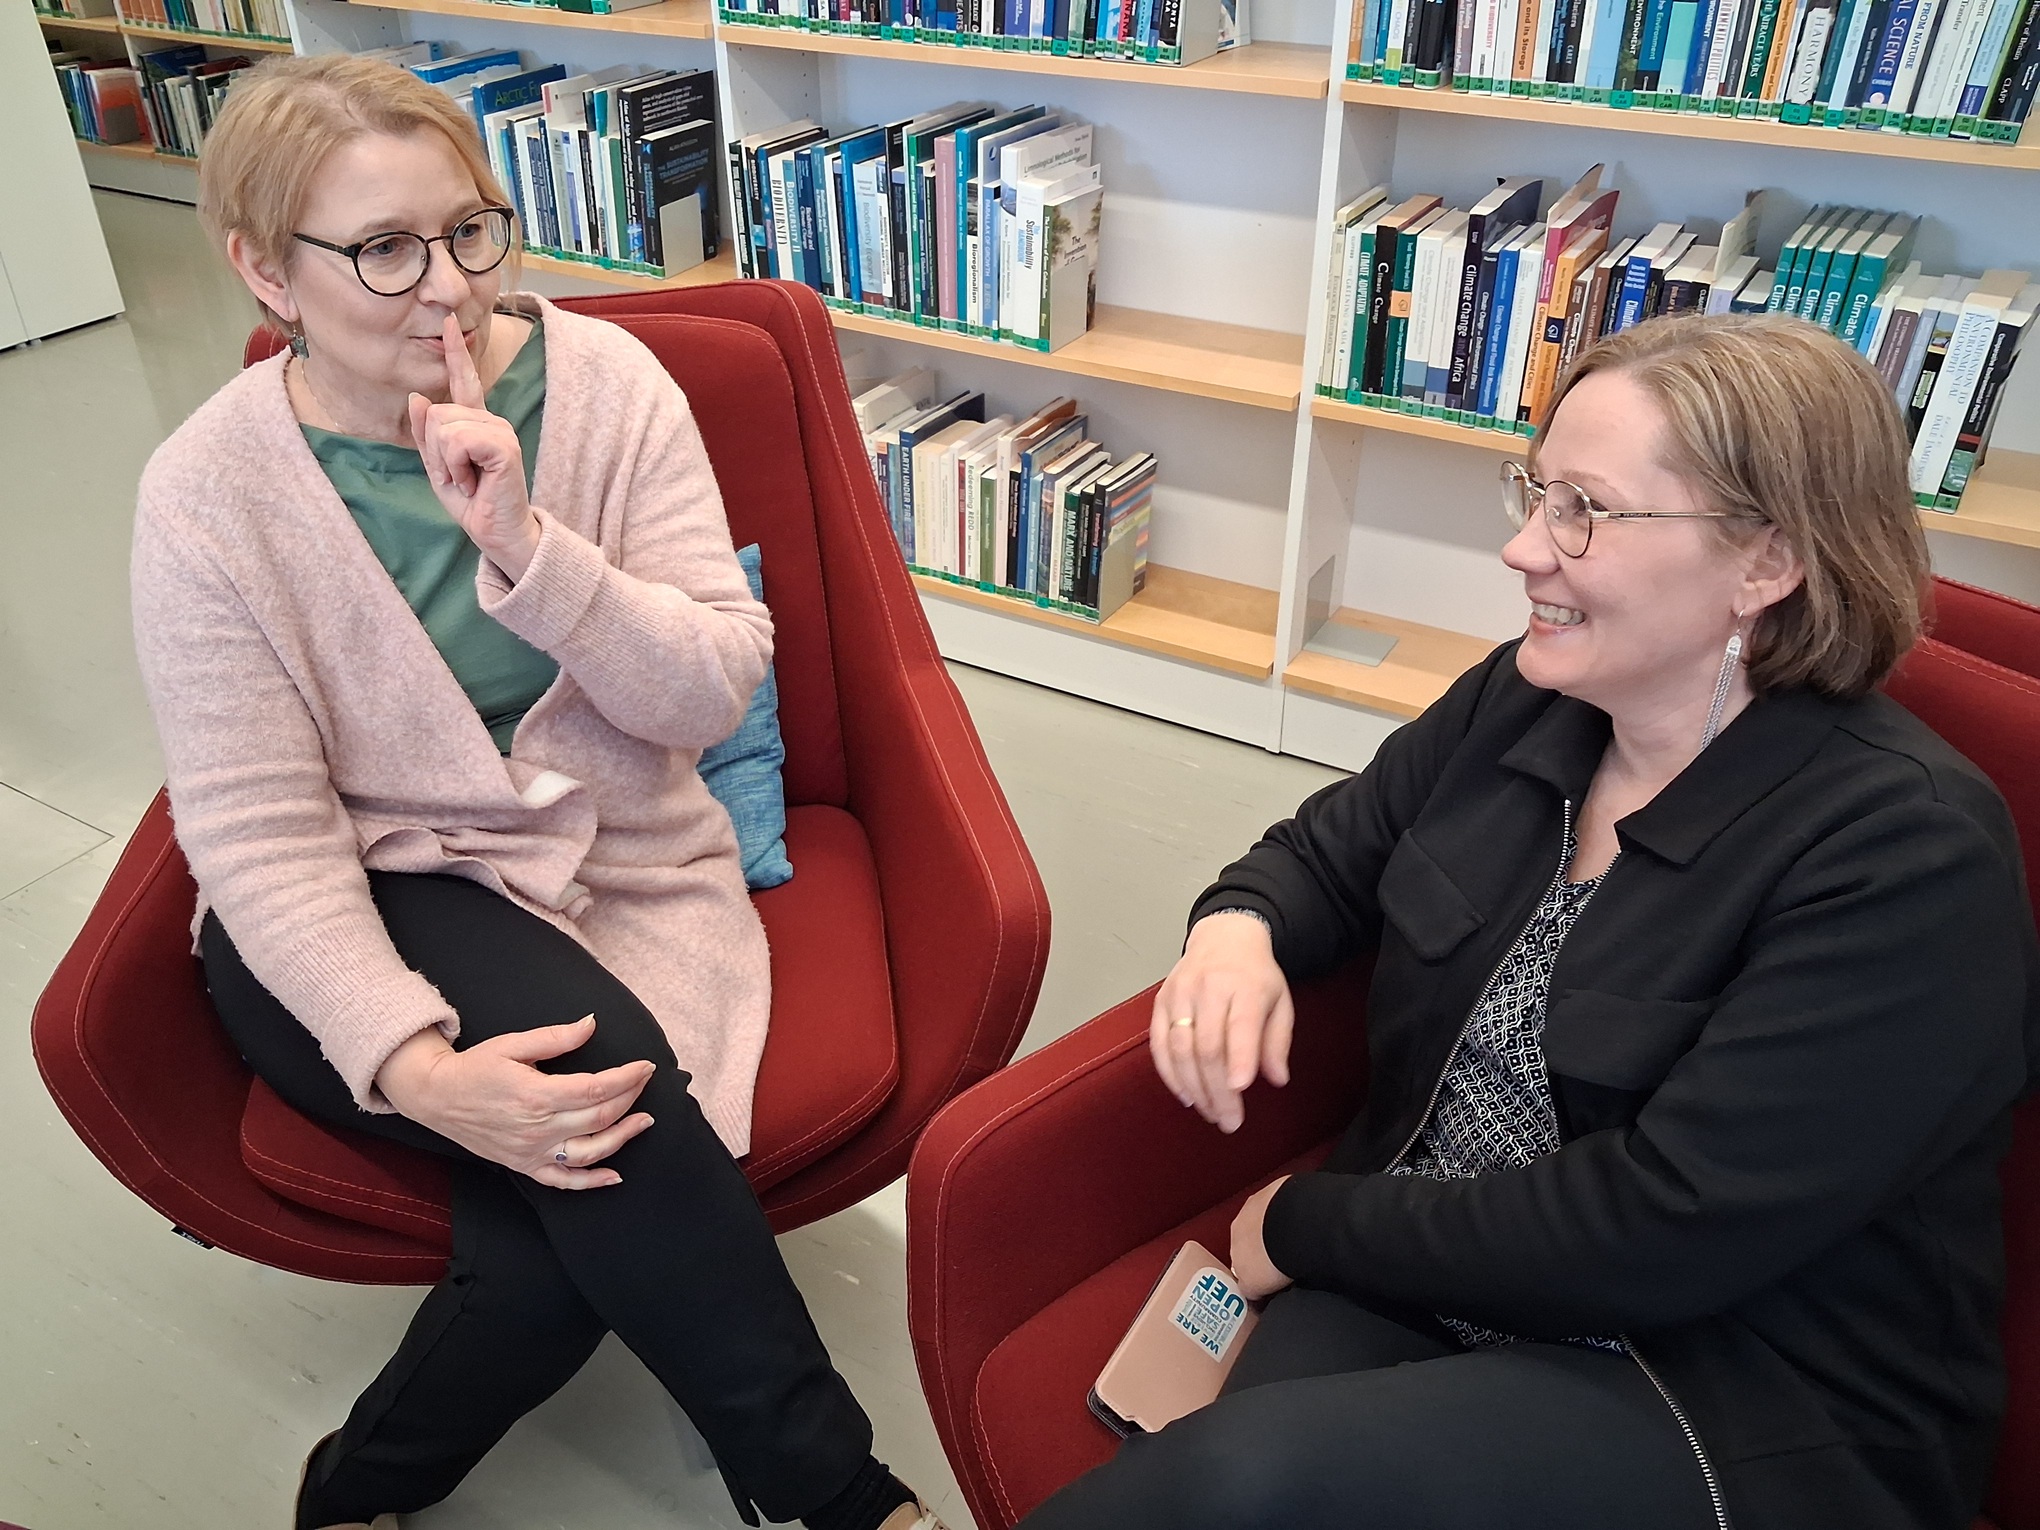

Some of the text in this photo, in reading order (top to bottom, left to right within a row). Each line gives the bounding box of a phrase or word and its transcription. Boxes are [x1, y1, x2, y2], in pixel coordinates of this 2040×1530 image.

[1393, 11, 1401, 40] CHAOS
[1456, 10, 1465, 54] Environmental
[1464, 4, 1472, 28] Building
[1486, 6, 1495, 48] BIODIVERSITY
[1629, 0, 1644, 55] ENVIRONMENT
[1953, 0, 1969, 31] Transfer
[1519, 7, 1533, 70] and its Storage
[1649, 12, 1663, 60] Environment
[1750, 14, 1772, 77] MIRACLE YEARS
[1775, 43, 1783, 56] Earth
[1879, 18, 1907, 75] SCIENCE
[1905, 2, 1932, 69] FROM NATURE
[1998, 0, 2039, 104] History of Britain CLAPP
[1566, 45, 1574, 64] CAREY
[1707, 49, 1723, 81] POLITICS
[1770, 56, 1780, 74] Systems
[1799, 17, 1826, 96] HARMONY
[1024, 155, 1054, 173] Limnological
[1055, 149, 1074, 161] Methods
[751, 159, 760, 201] BIODIVERSITY
[772, 179, 787, 246] BIODIVERSITY
[786, 181, 798, 242] BIODIVERSITY
[863, 202, 873, 245] Biodiversity
[984, 236, 990, 245] OF
[1017, 228, 1025, 263] HANDBOOK
[1024, 219, 1035, 270] Sustainability
[1071, 235, 1081, 245] The
[1356, 252, 1370, 315] CLIMATE ADAPTATION
[1372, 262, 1389, 324] Climate Change
[1611, 293, 1620, 308] Change
[1769, 284, 1786, 313] Clim
[1785, 286, 1802, 312] Clim
[1340, 278, 1352, 345] GREENING ASIA
[1495, 305, 1504, 323] Climate
[1535, 307, 1546, 332] Climate
[1622, 300, 1639, 328] Climate
[1802, 289, 1820, 320] Clima
[1820, 291, 1841, 330] Climat
[1845, 293, 1868, 336] Climate
[1327, 314, 1337, 354] RESTORATION
[1451, 264, 1477, 382] Climate Change and Africa
[1470, 292, 1489, 390] Climate Change Environmental Ethics
[1492, 324, 1502, 341] Change
[1565, 312, 1581, 363] Climate Change
[1490, 352, 1498, 365] Flood
[1530, 333, 1542, 357] Change
[1544, 345, 1553, 365] Climate
[1945, 312, 1975, 374] PHILOSOPHY
[1949, 314, 1986, 399] ENVIRONMENTAL
[1966, 326, 1993, 386] COMPANION
[1488, 366, 1496, 376] Risk
[1526, 372, 1536, 389] Cities
[1969, 333, 2006, 423] Comparative Environmental Politics
[1483, 377, 1495, 407] Management
[1958, 391, 1970, 405] TO
[1929, 414, 1944, 437] DALE
[901, 446, 910, 474] EARTH
[1913, 440, 1935, 483] JAMIESON
[903, 475, 911, 503] UNDER
[1092, 512, 1100, 547] transforming
[1063, 510, 1077, 592] MARX AND NATURE
[1190, 1295, 1222, 1323] COMMUNITY
[1192, 1285, 1231, 1321] OPEN
[1198, 1274, 1245, 1317] UEF
[1176, 1312, 1220, 1355] WE ARE
[1197, 1308, 1219, 1330] SAFE
